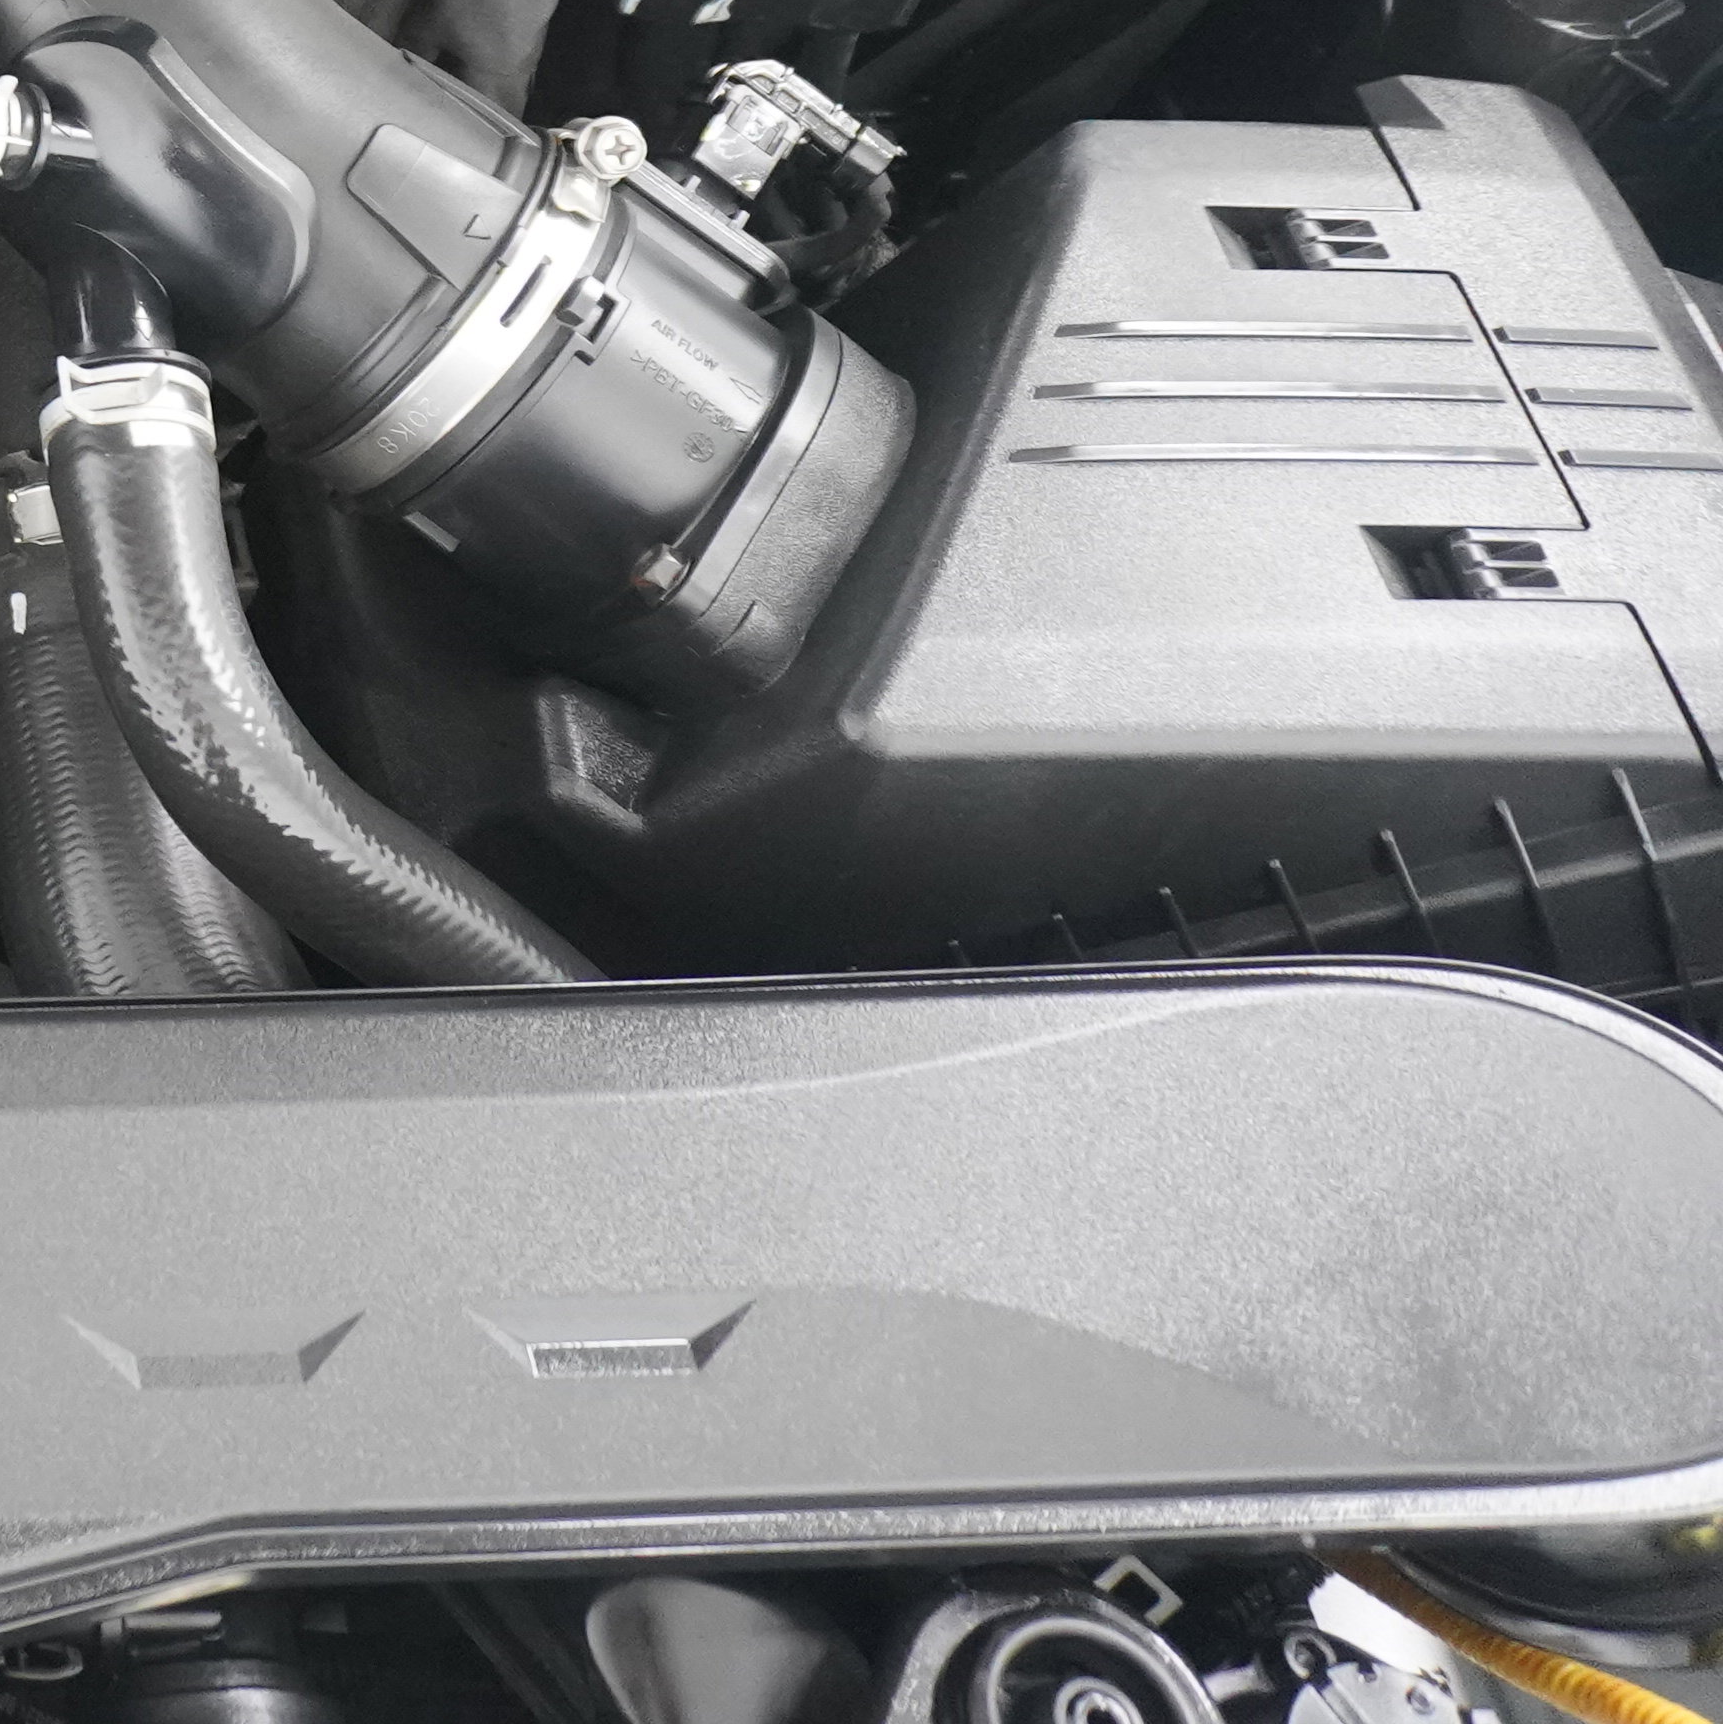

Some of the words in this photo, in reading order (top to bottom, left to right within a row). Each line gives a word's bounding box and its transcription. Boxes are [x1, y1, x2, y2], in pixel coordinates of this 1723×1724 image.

[651, 319, 677, 341] AIR
[677, 337, 719, 371] FLOW
[376, 396, 440, 454] 20K8
